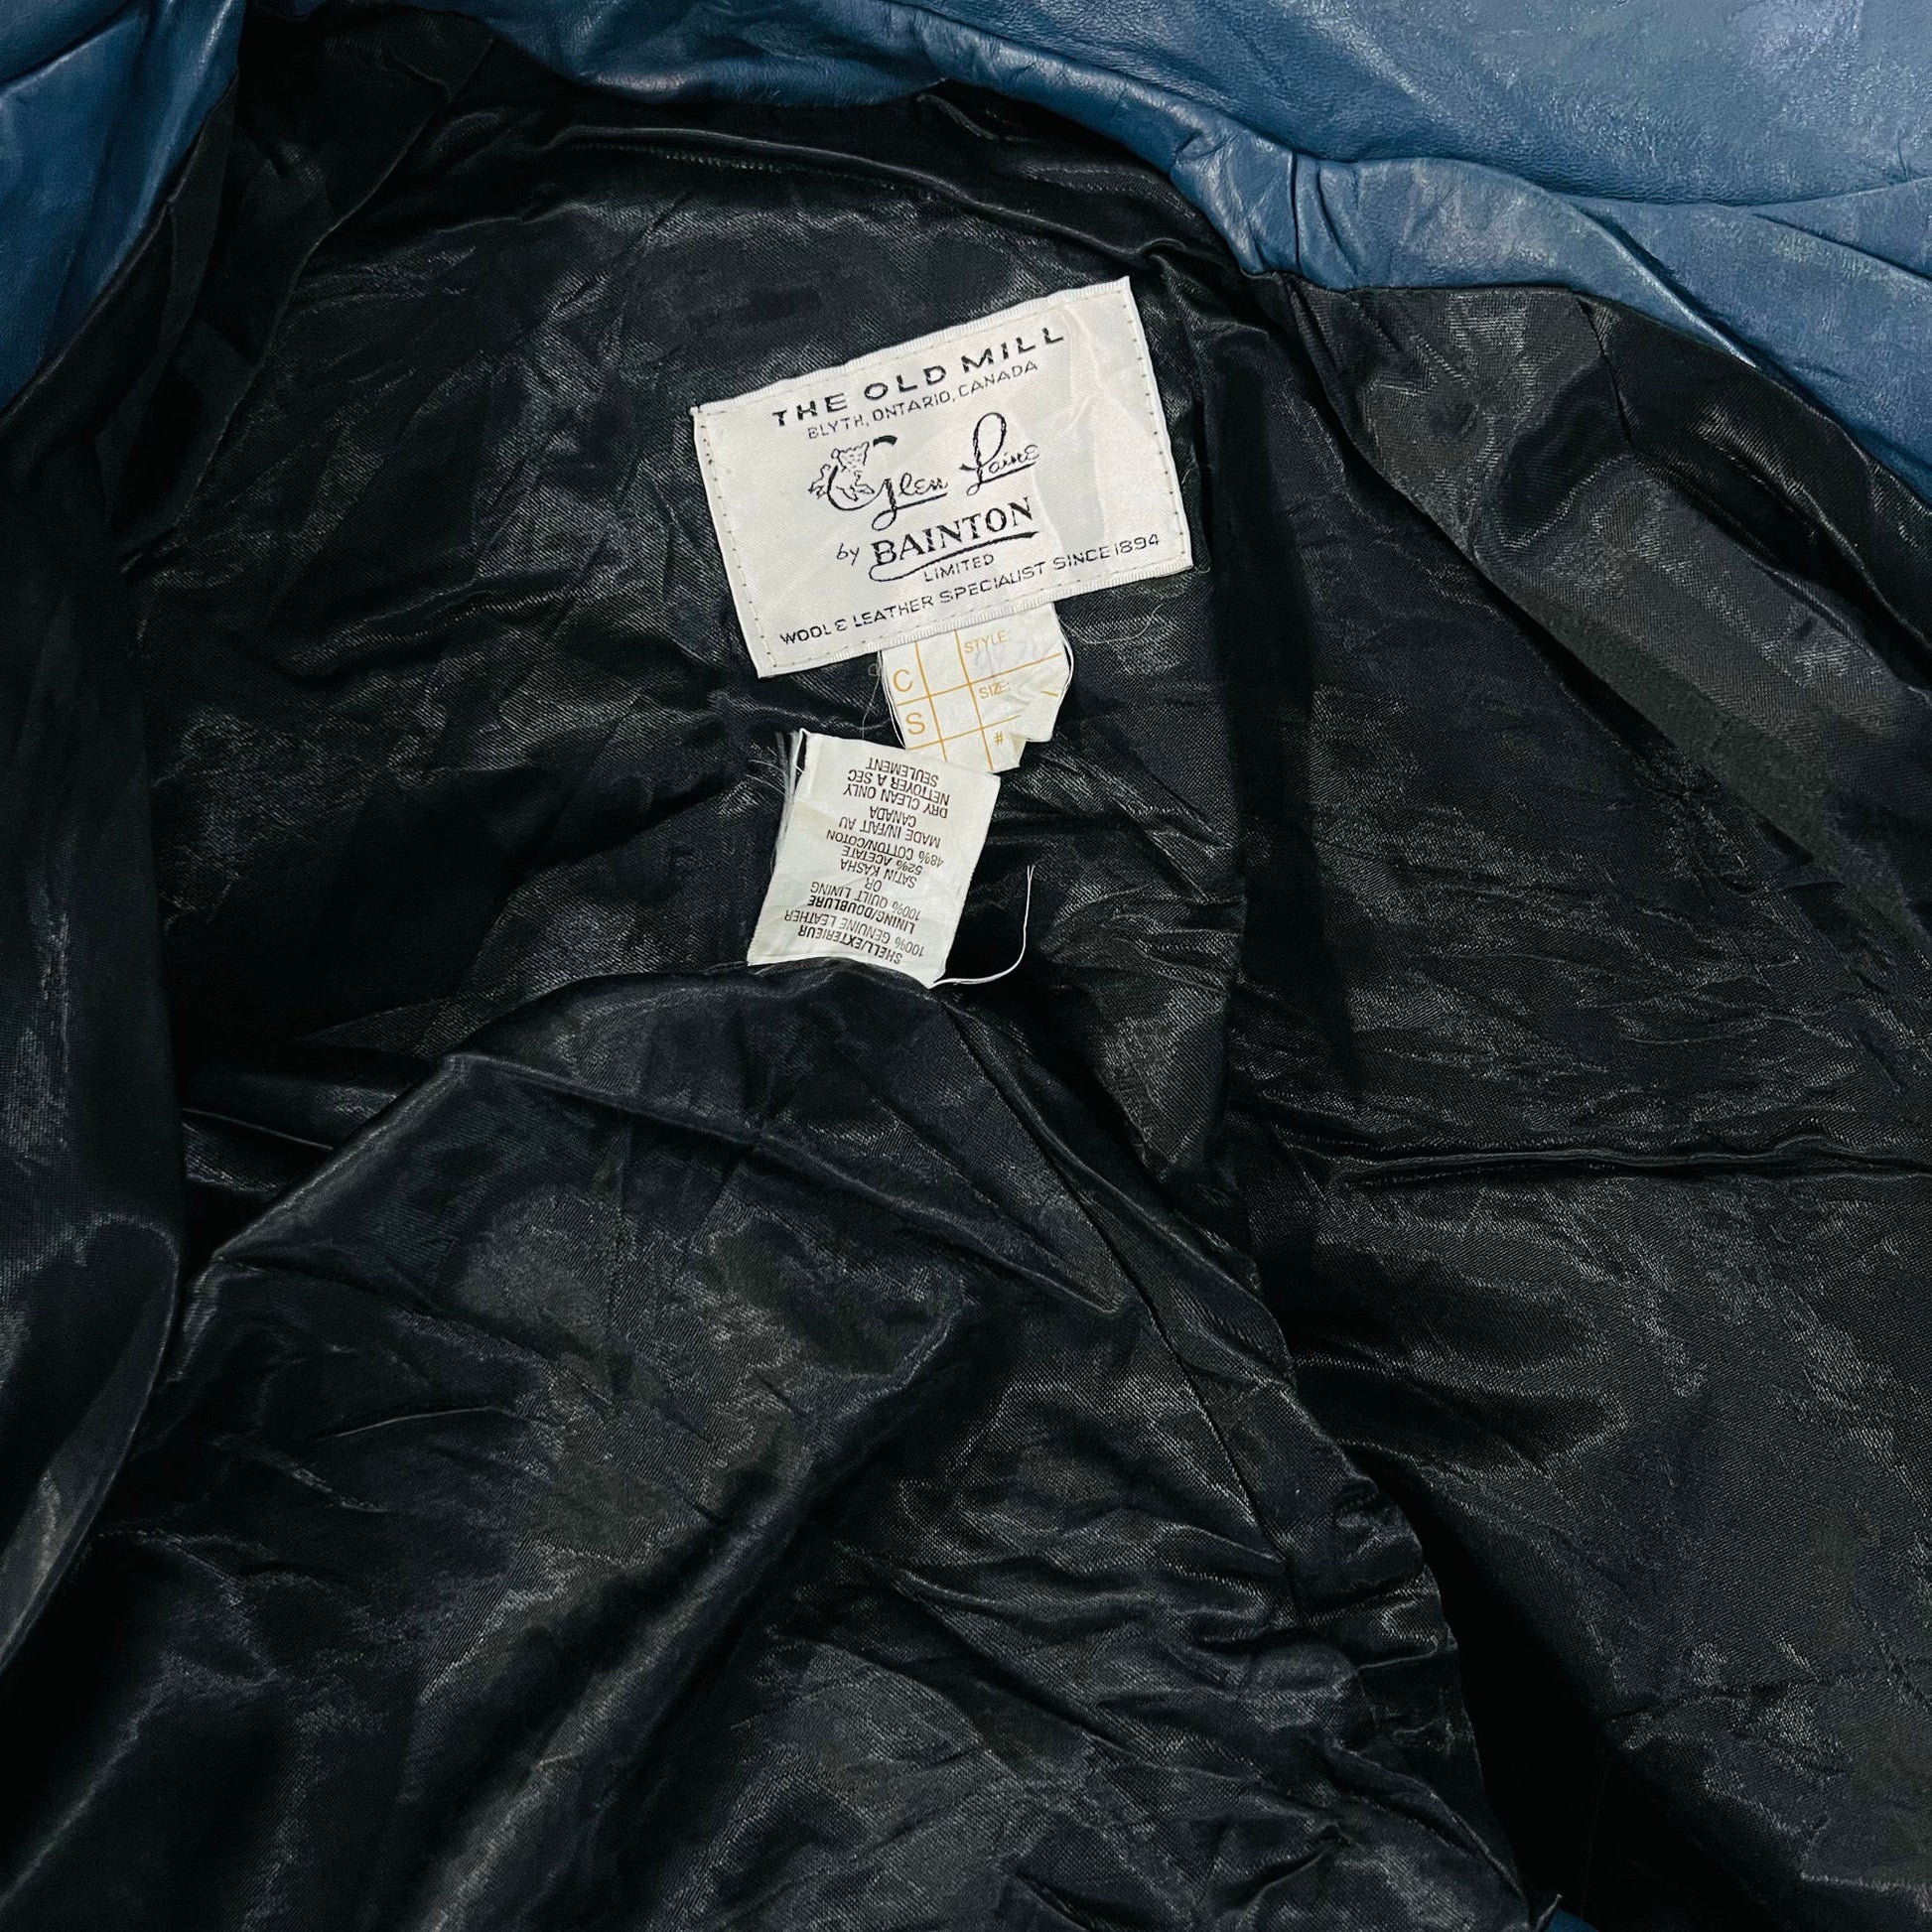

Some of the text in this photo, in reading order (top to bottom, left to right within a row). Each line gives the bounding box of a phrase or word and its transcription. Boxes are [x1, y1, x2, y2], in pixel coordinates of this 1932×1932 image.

[772, 327, 1064, 427] THE OLD MILL
[807, 360, 1038, 439] BLYTH, ONTARIO, CANADA
[836, 496, 1035, 566] by BAINTON
[923, 553, 995, 582] LIMITED
[779, 624, 833, 646] WOOL
[854, 596, 934, 627] LEATHER
[940, 562, 1045, 604] SPECIALIST
[893, 668, 913, 693] C
[978, 681, 1011, 699] SIZE:
[904, 712, 926, 736] S
[847, 769, 950, 806] NETTOYER A SEC
[866, 758, 939, 787] SEULEMENT
[843, 783, 948, 819] DRY CLEAN ONLY
[870, 805, 916, 827] CANADA
[826, 829, 945, 868] 48% COTTON/COTON
[839, 816, 941, 849] MADE IN/FAIT AU
[840, 858, 917, 889] SATIN KASHA
[841, 845, 923, 876] 52% ACETATE
[810, 881, 921, 921] 100% QUILT LINING
[864, 878, 883, 893] OR
[807, 895, 915, 934] LINING/DOUBLURE
[783, 909, 924, 958] 100% GENUINE LEATHER
[797, 924, 902, 965] SHELL/EXTERIEUR
